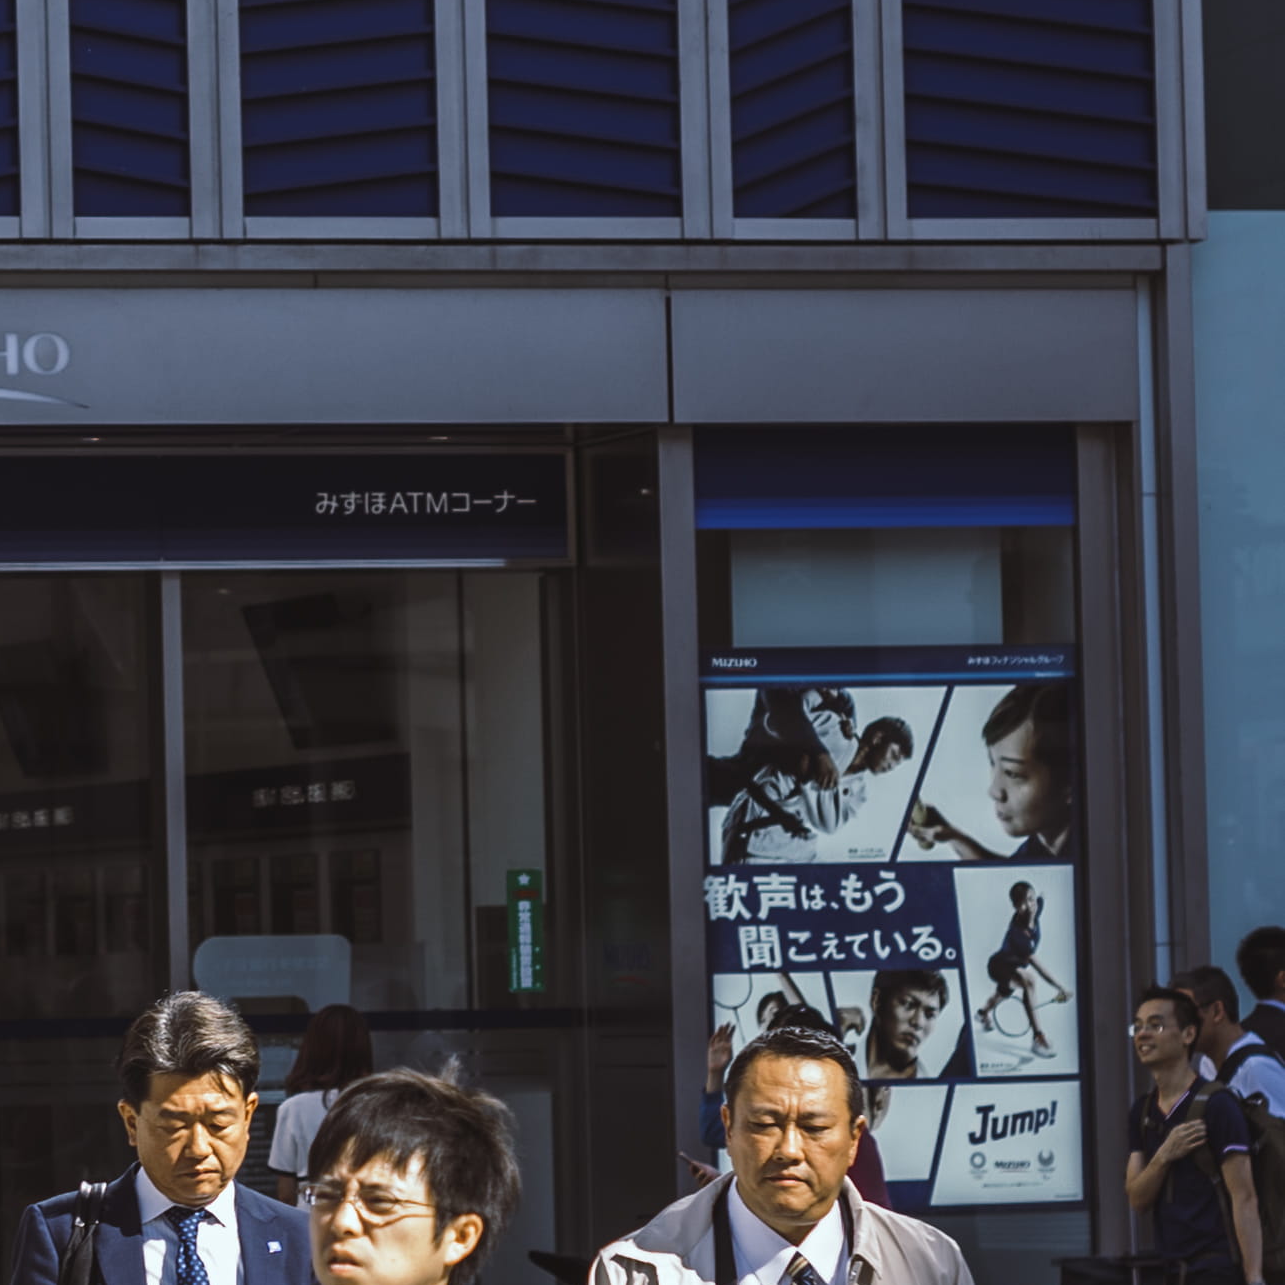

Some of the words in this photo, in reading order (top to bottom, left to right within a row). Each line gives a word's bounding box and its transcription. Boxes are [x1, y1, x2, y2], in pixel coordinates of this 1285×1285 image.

[315, 491, 537, 514] みずほATMコーナー
[703, 870, 905, 921] 歓声は、もう
[738, 925, 957, 970] 聞こえている。
[968, 1101, 1057, 1146] Jump!
